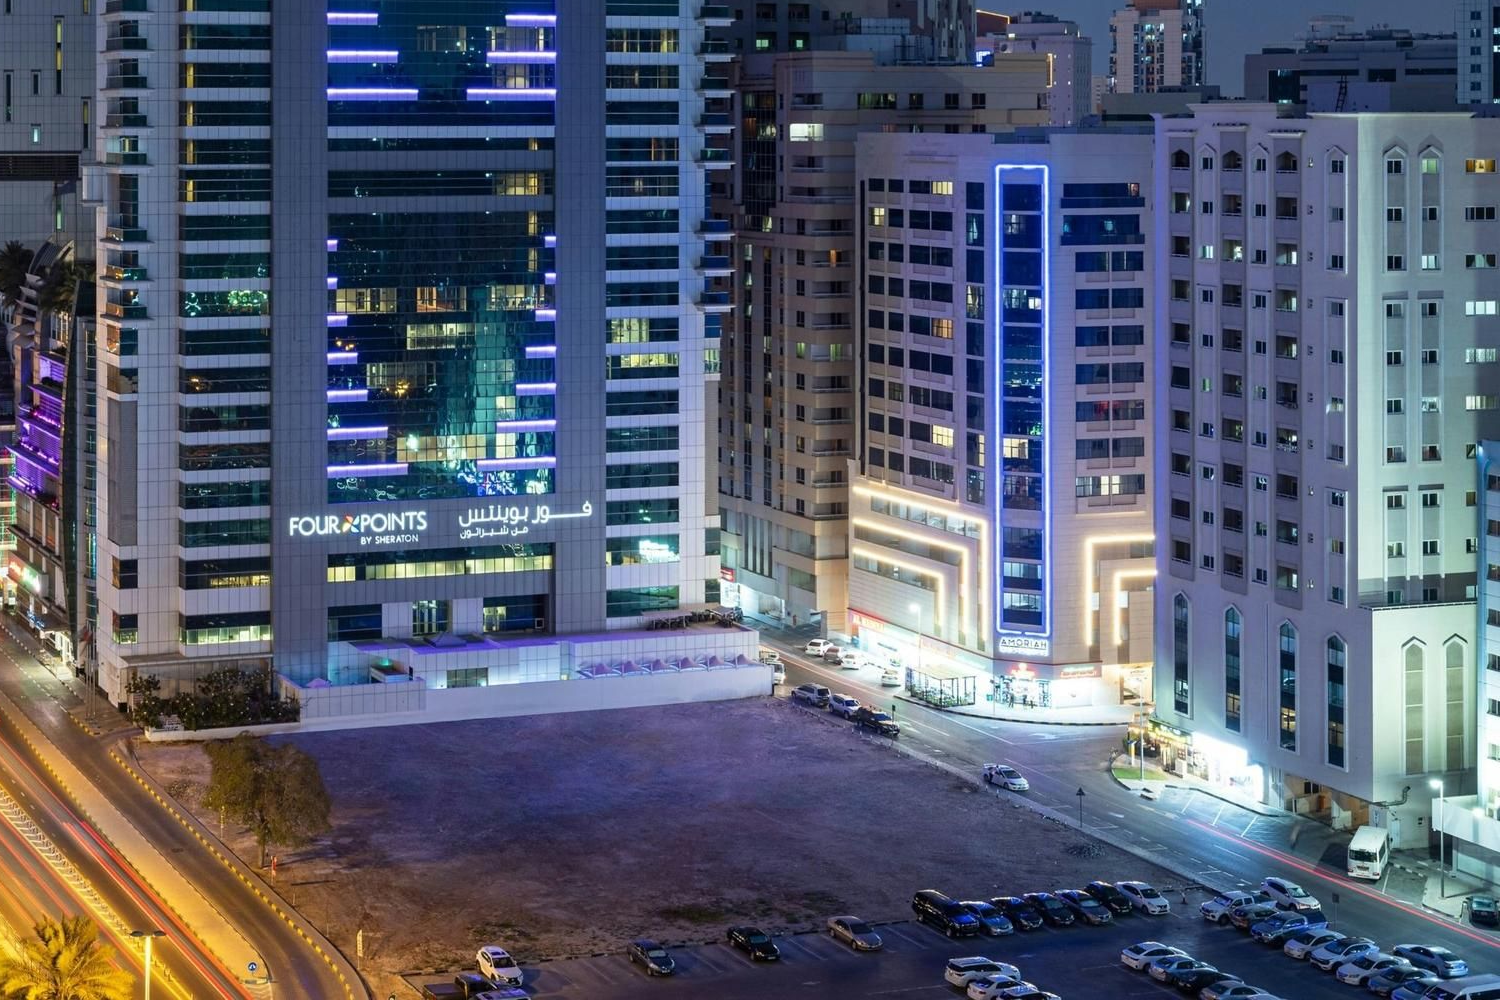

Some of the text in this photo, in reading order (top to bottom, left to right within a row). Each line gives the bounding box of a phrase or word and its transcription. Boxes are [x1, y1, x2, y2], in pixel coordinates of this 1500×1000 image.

[289, 510, 428, 536] FOUR POINTS
[360, 534, 419, 545] BY SHERATON
[1001, 639, 1047, 649] AMORIAH
